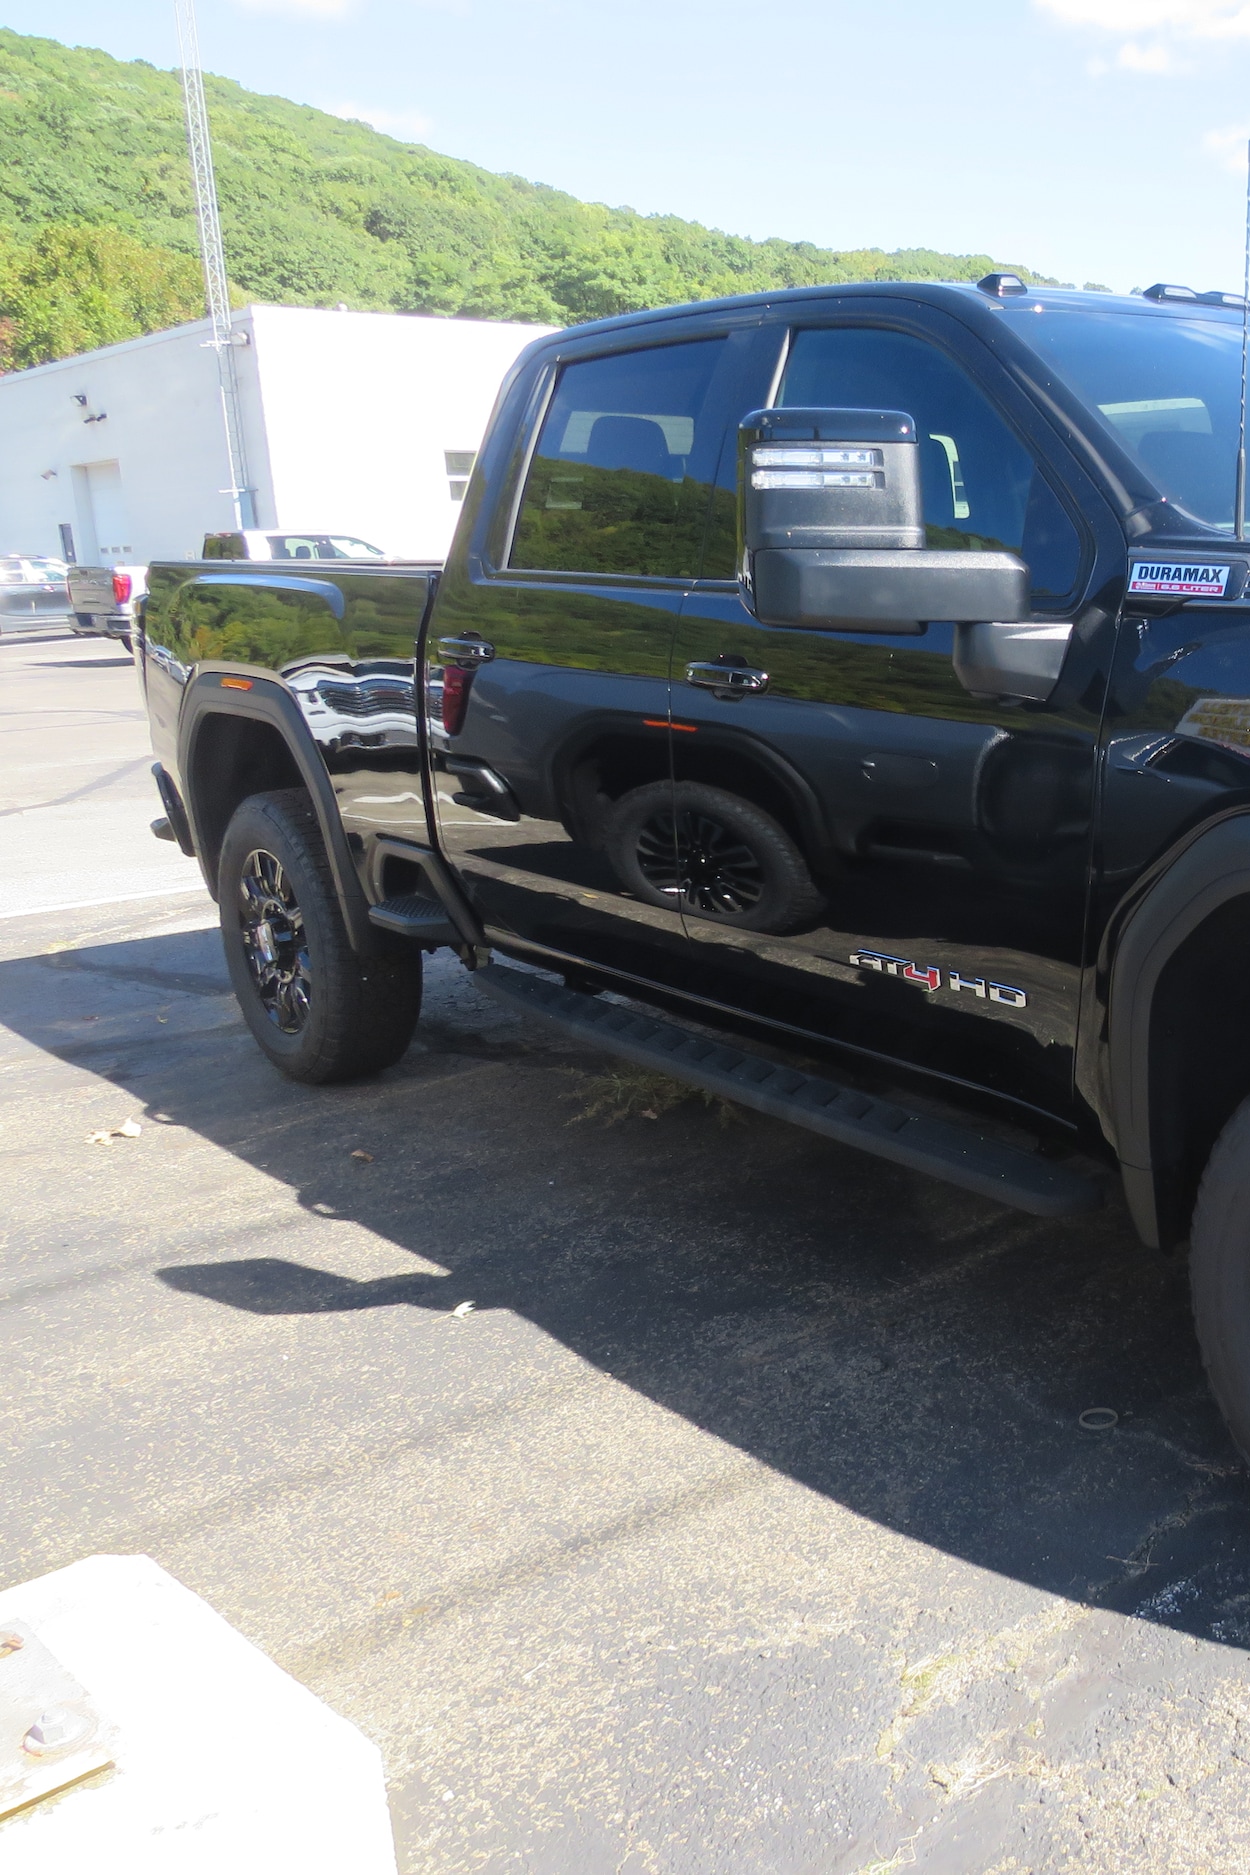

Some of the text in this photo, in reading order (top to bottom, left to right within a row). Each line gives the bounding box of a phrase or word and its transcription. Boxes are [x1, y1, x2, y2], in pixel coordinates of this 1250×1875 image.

[1138, 565, 1224, 583] DURAMAX
[1182, 585, 1220, 594] LITER
[849, 949, 1027, 1009] AT4 HD
